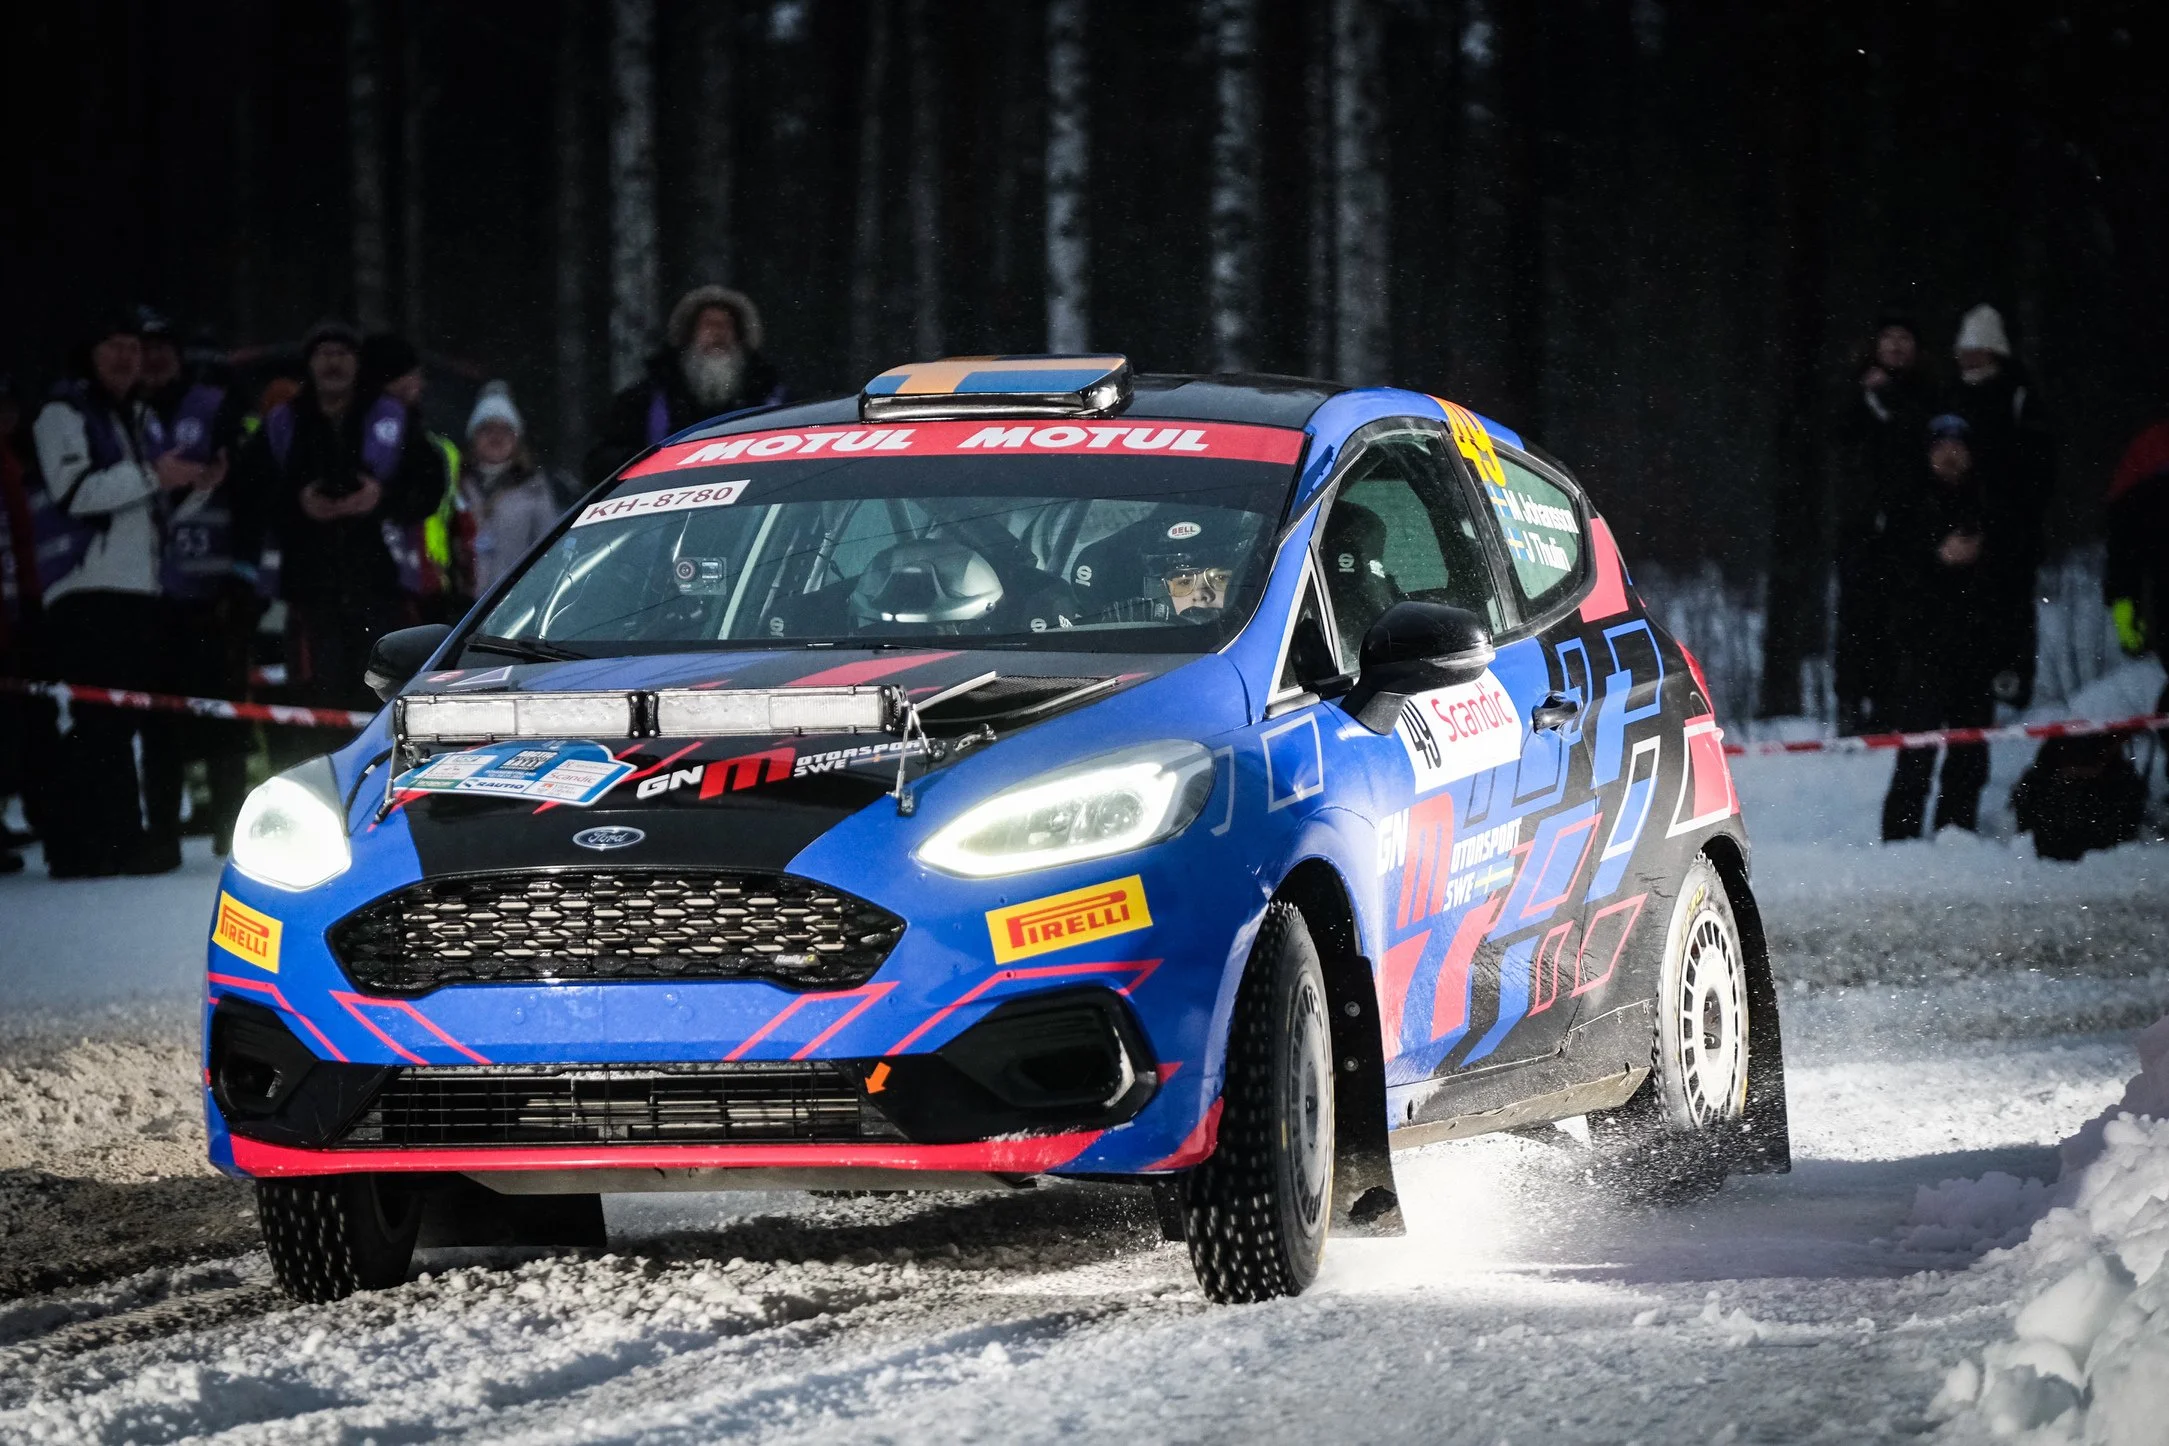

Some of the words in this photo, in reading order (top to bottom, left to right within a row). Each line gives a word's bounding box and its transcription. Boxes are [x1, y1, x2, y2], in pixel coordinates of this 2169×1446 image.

[676, 429, 917, 466] MOTUL
[956, 426, 1210, 451] MOTUL
[586, 486, 734, 520] KH-8780
[1501, 488, 1526, 522] M
[1172, 526, 1196, 535] BELL
[1400, 699, 1442, 770] 49
[1431, 682, 1513, 742] Scandic
[549, 771, 595, 784] Scandic
[793, 758, 847, 777] SWE
[476, 781, 525, 790] RAUTIO
[587, 830, 629, 843] Ford
[1441, 871, 1476, 912] SWE
[220, 904, 270, 958] PIRELLI
[1005, 889, 1131, 949] PIRELLI
